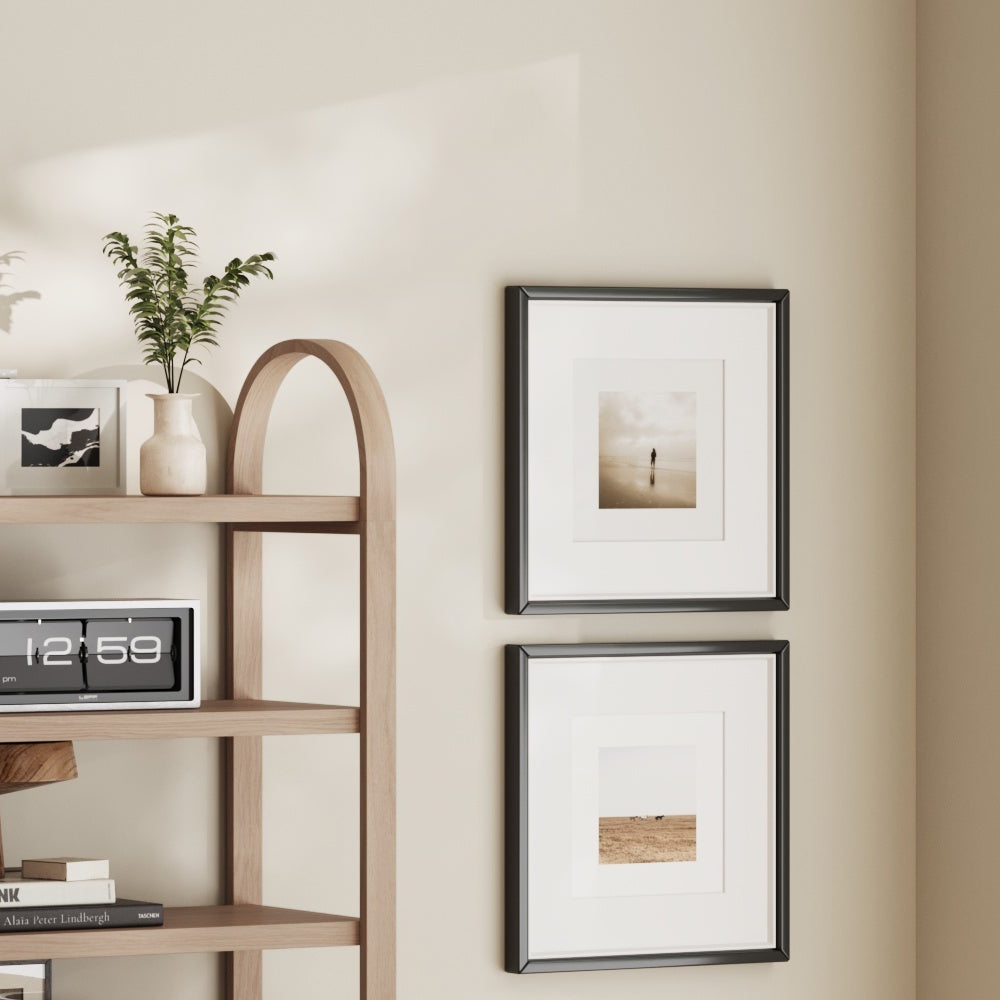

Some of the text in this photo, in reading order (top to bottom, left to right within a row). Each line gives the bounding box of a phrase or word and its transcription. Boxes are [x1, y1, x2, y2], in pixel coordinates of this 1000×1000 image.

[2, 676, 16, 684] pm
[33, 912, 58, 926] Peter
[61, 910, 110, 925] Lindbergh
[137, 911, 160, 919] TASCHEN
